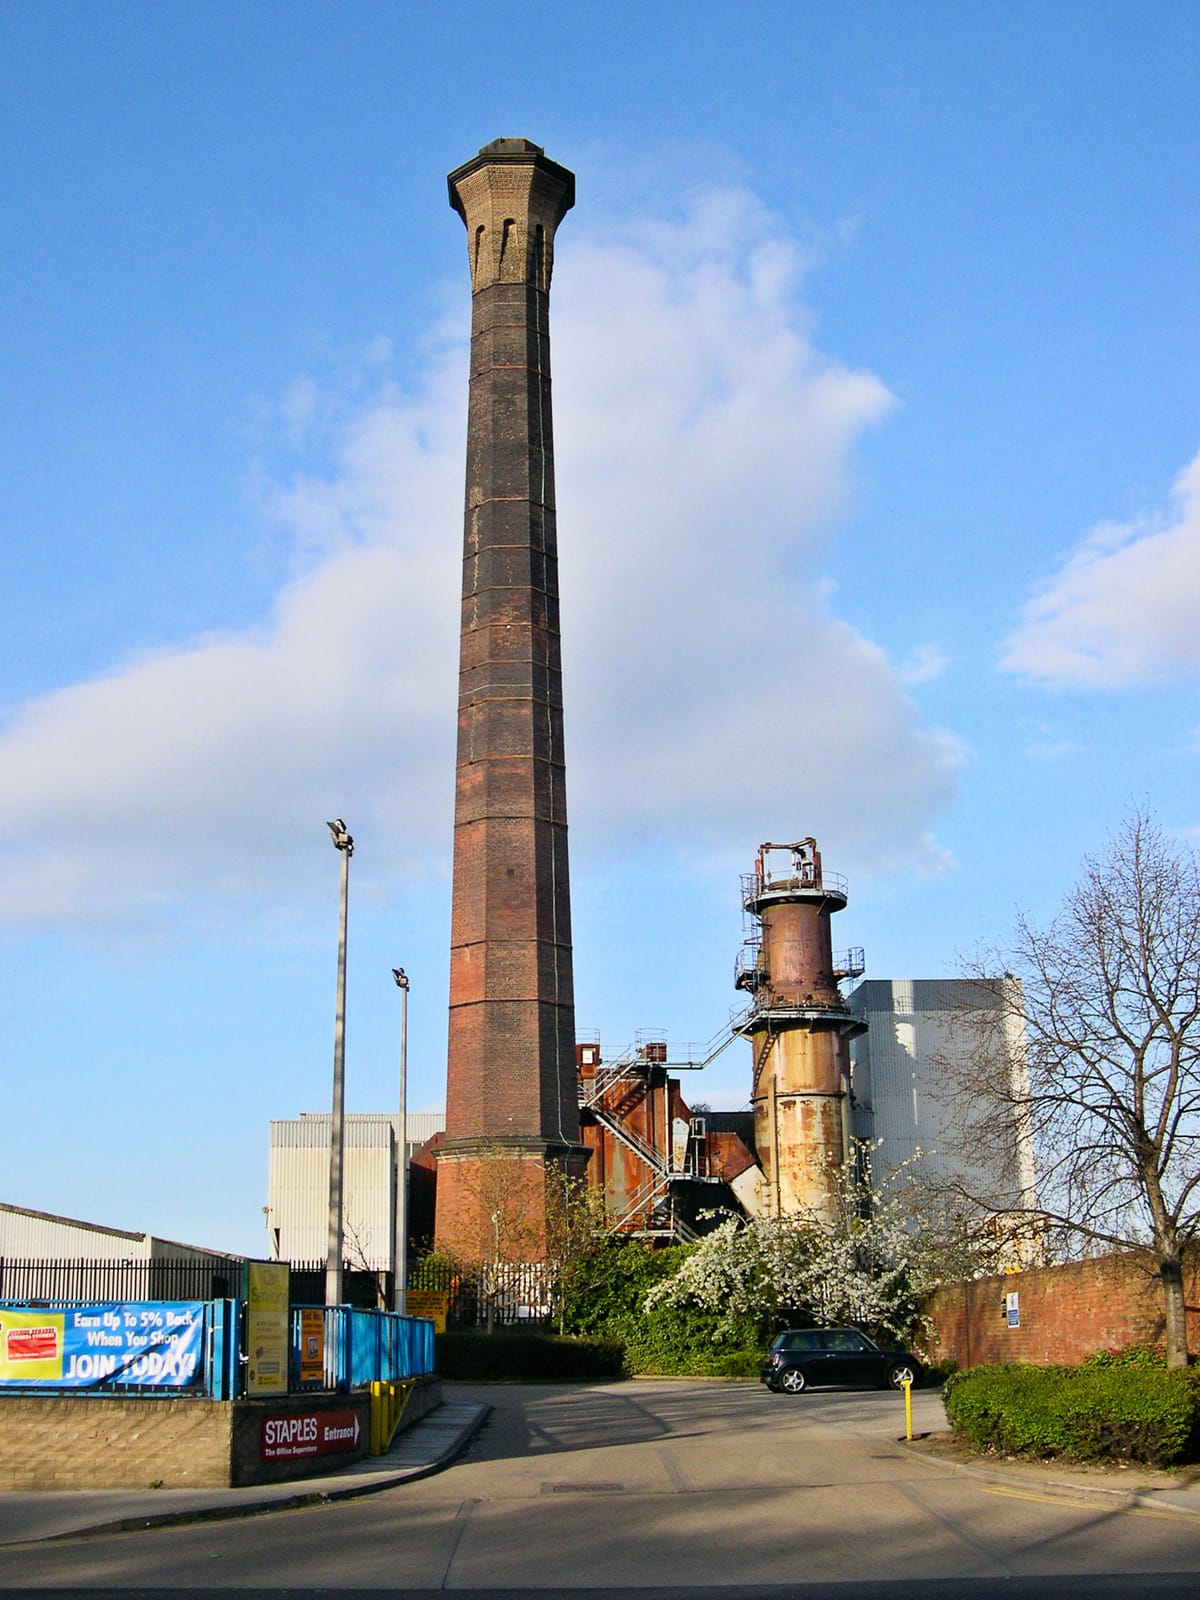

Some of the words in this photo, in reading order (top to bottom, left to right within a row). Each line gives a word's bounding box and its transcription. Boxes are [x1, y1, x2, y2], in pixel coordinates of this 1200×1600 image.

[74, 1312, 100, 1327] Earn
[103, 1312, 120, 1331] Up
[123, 1312, 137, 1326] To
[140, 1311, 163, 1326] 5%
[166, 1310, 193, 1325] Back
[87, 1331, 122, 1346] When
[125, 1331, 147, 1345] You
[150, 1330, 179, 1347] Shop
[65, 1354, 115, 1378] JOIN
[121, 1352, 196, 1376] TODAY!
[265, 1417, 317, 1444] STAPLES
[324, 1427, 353, 1441] Entrance
[265, 1448, 275, 1456] The
[276, 1447, 291, 1455] Office
[292, 1446, 317, 1455] Superstore
